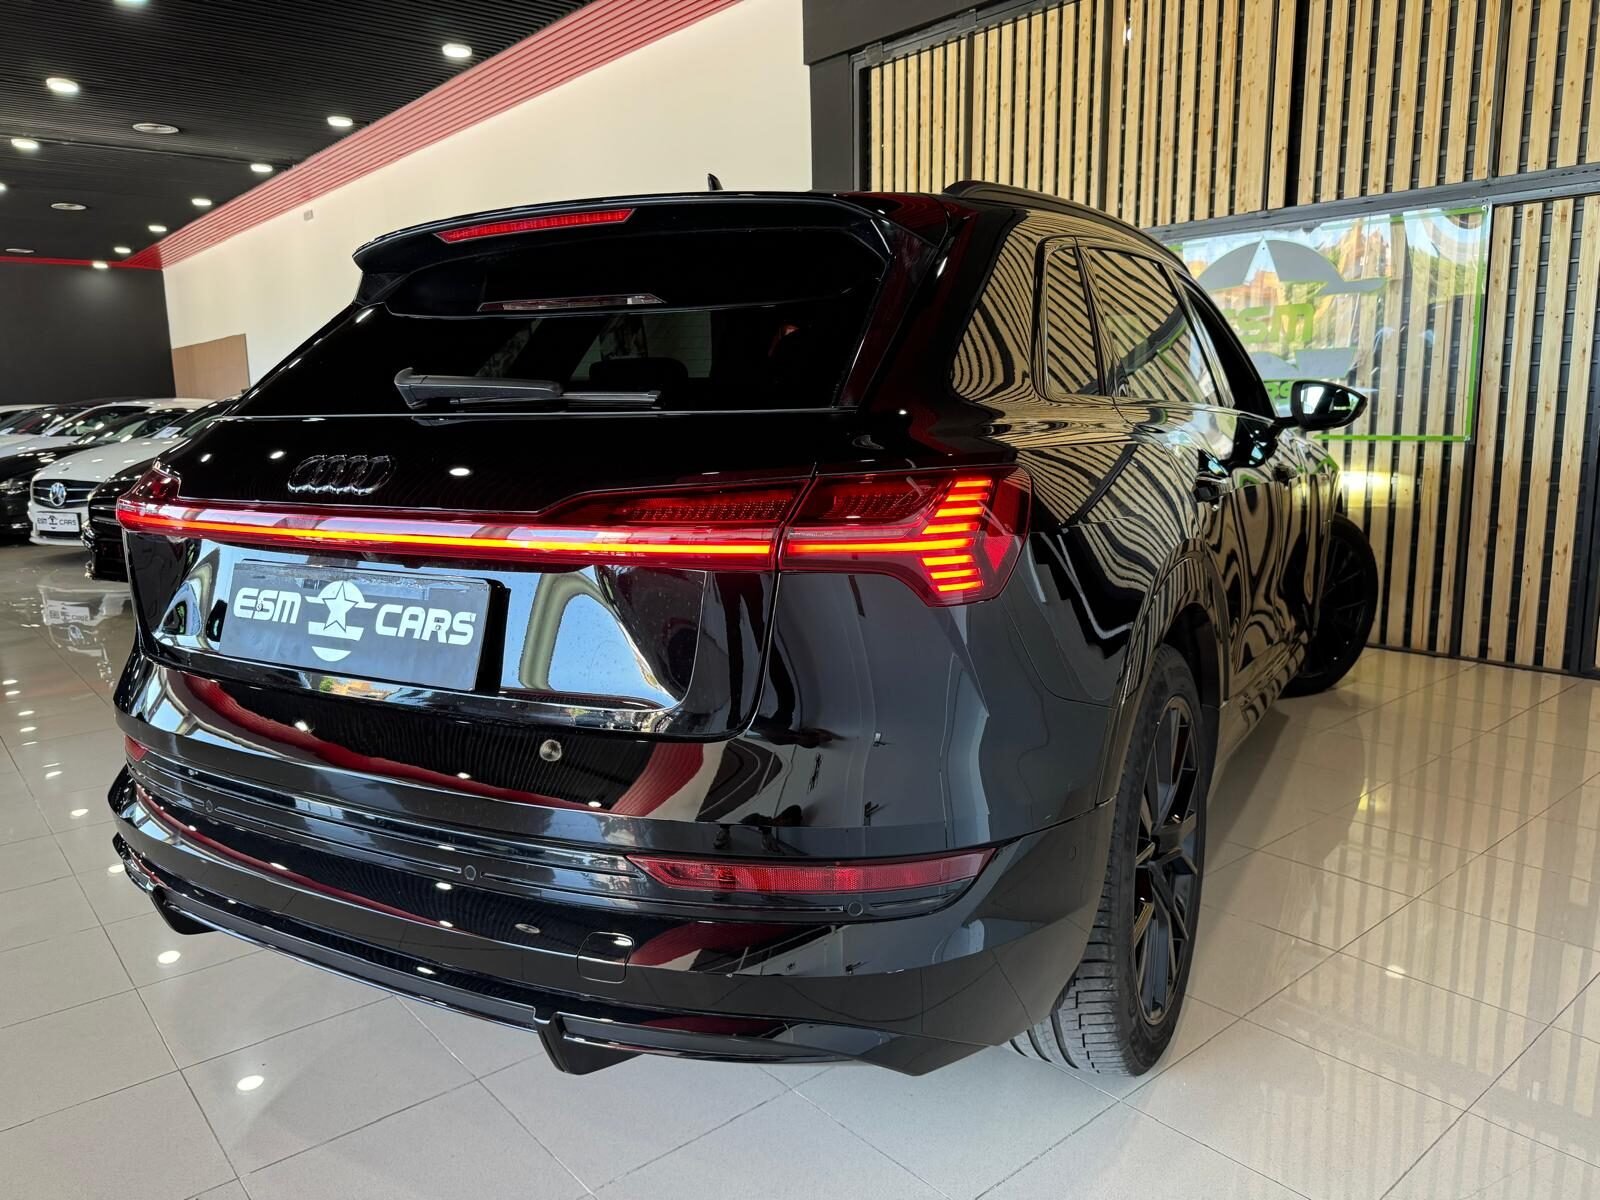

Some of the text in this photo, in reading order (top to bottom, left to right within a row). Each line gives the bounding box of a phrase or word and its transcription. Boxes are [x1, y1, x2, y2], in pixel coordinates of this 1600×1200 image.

[1223, 303, 1315, 343] SM
[233, 587, 477, 646] ESM CARS
